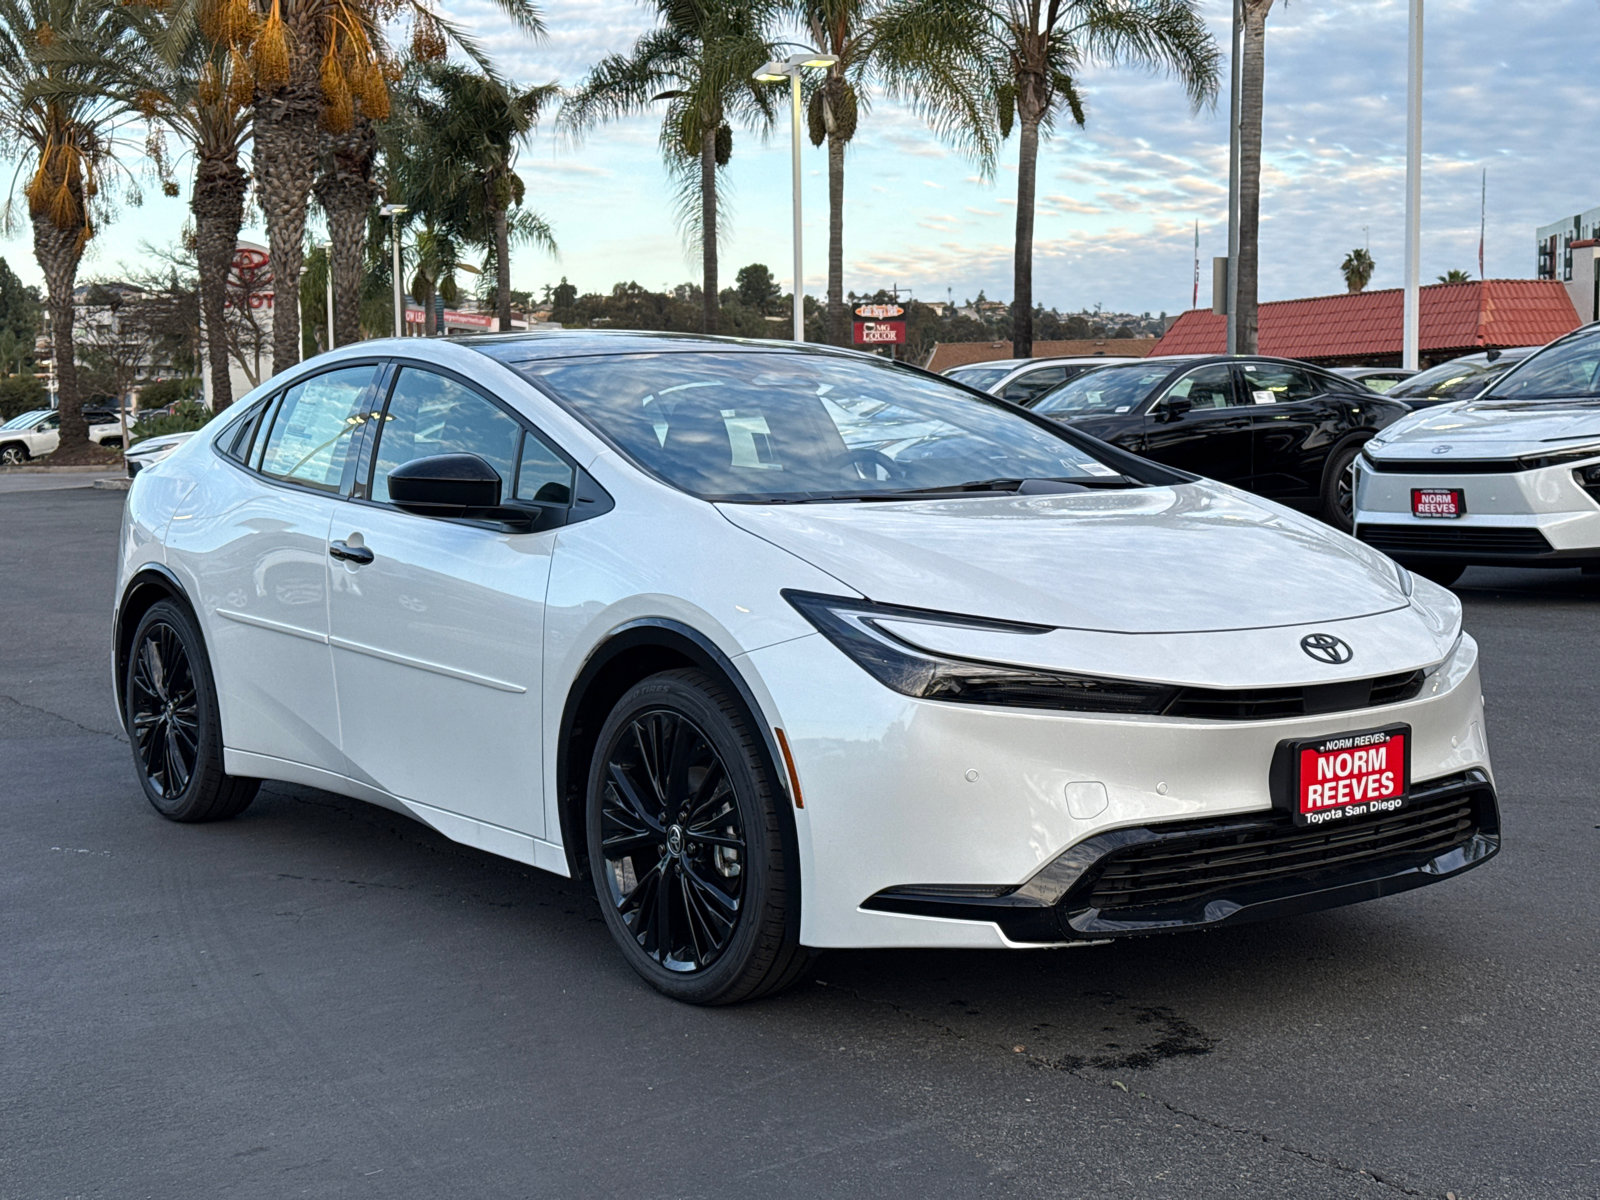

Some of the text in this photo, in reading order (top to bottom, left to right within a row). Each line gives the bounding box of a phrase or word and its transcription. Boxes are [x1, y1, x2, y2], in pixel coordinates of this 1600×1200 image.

[1418, 503, 1456, 513] REEVES
[1421, 494, 1452, 504] NORM
[1326, 733, 1385, 751] NORM REEVES
[1317, 747, 1387, 780] NORM
[1307, 771, 1394, 808] REEVES
[1305, 798, 1402, 824] Toyota San Diego
